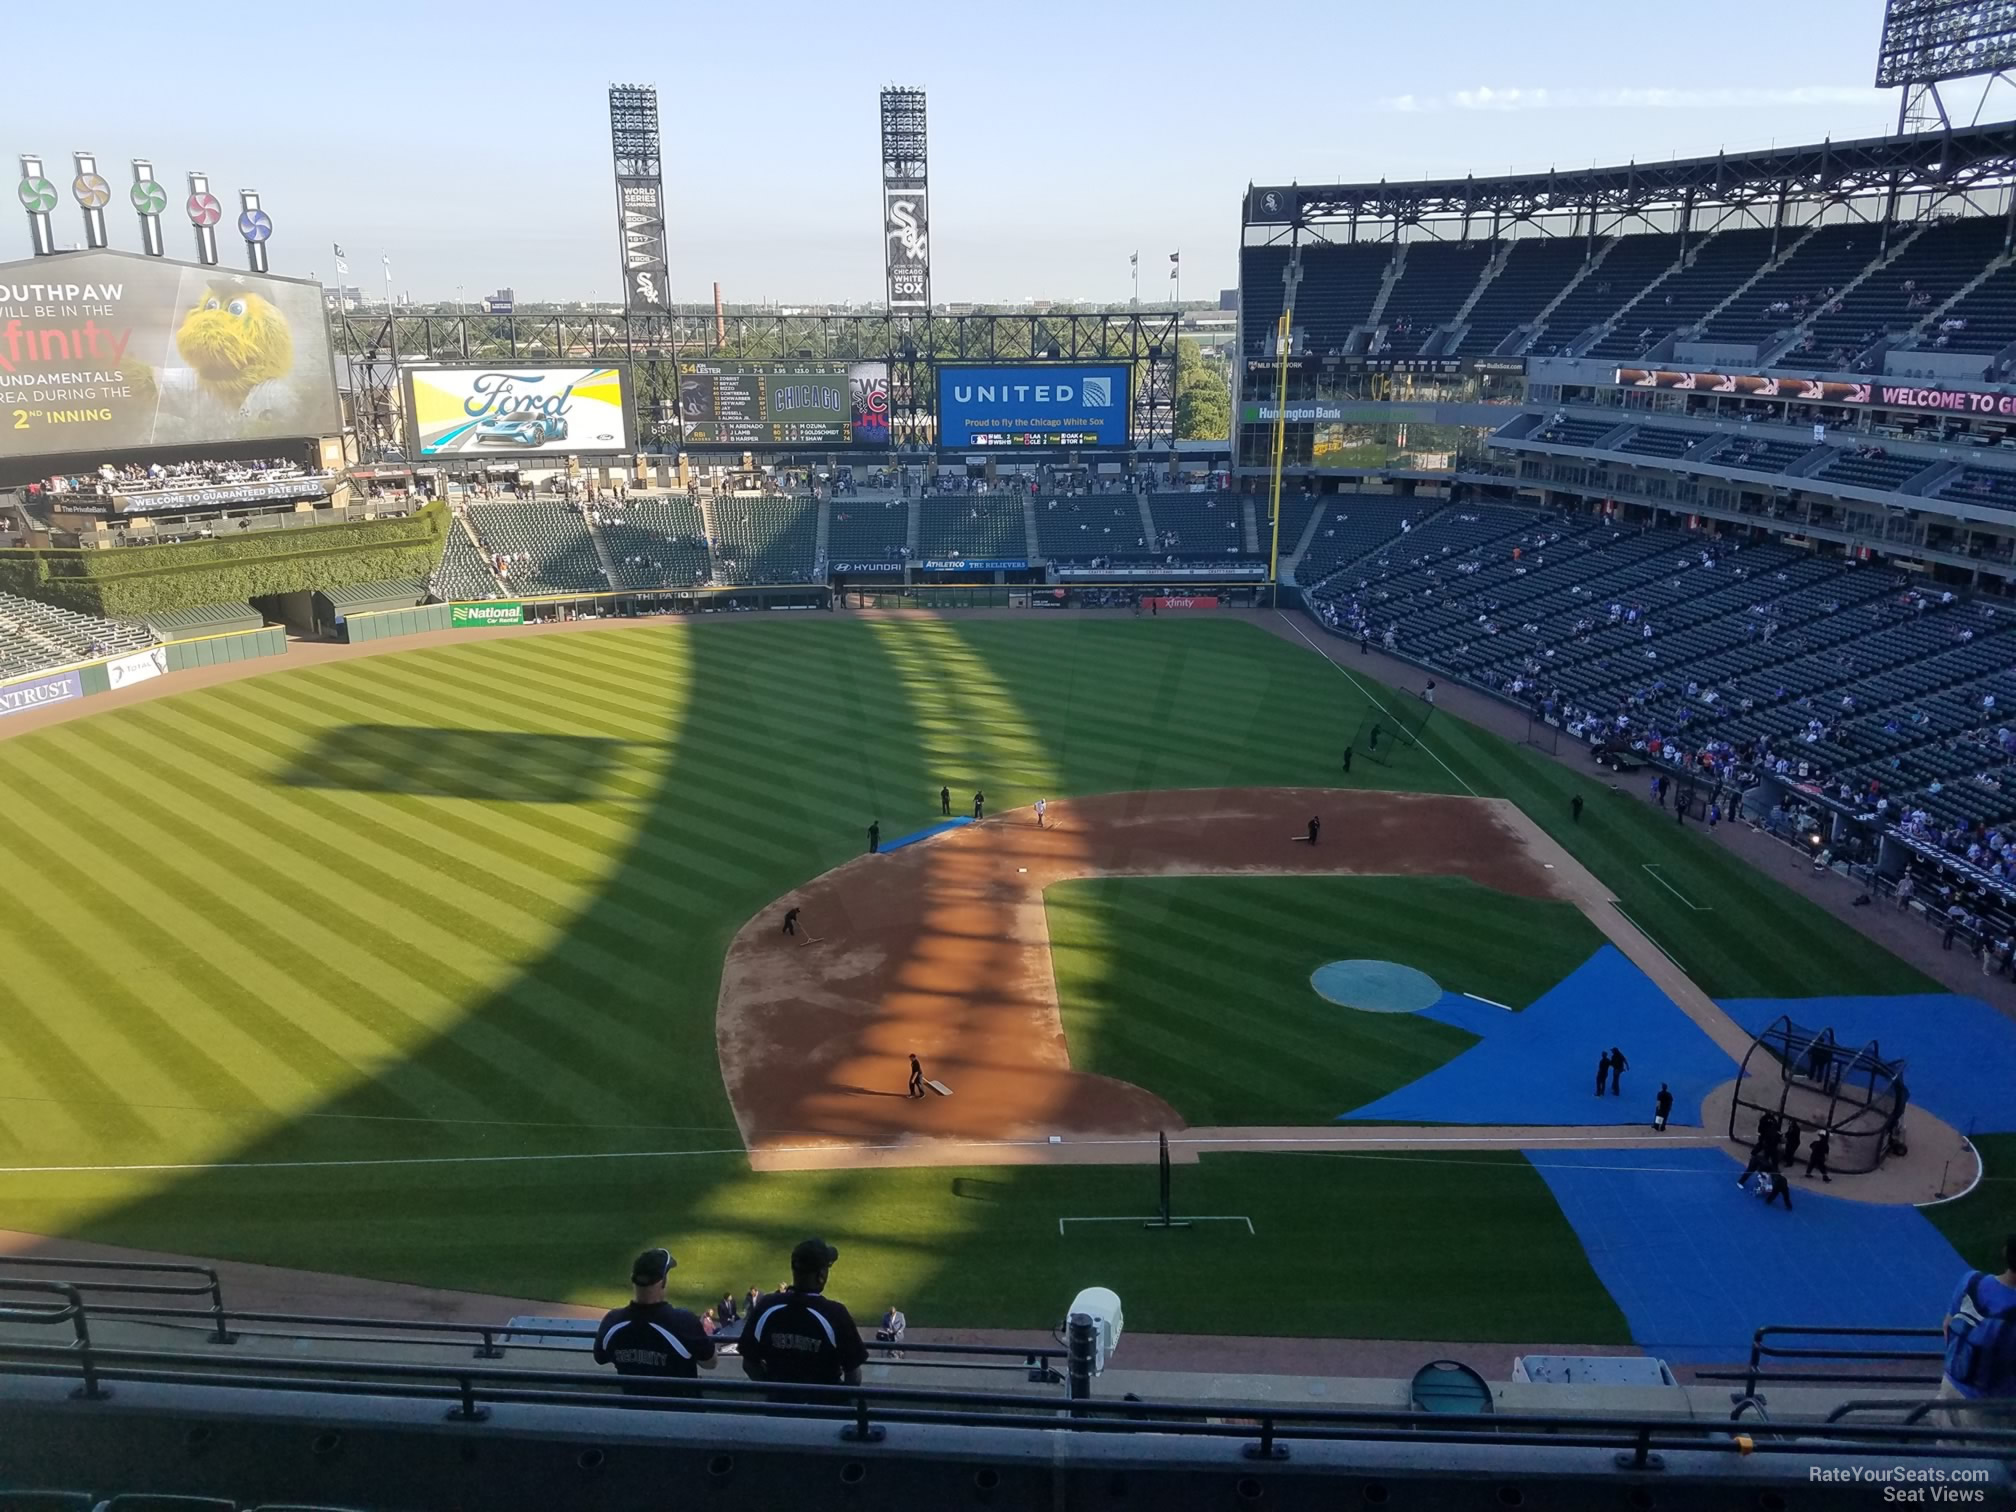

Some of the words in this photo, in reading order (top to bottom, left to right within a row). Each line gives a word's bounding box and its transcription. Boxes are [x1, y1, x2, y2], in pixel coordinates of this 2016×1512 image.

[894, 283, 924, 294] SOX
[34, 306, 56, 317] BE
[62, 306, 78, 316] IN
[82, 305, 114, 316] THE
[680, 364, 696, 374] 34
[34, 388, 96, 402] DURING
[101, 386, 132, 398] THE
[464, 373, 574, 417] Ford
[775, 384, 840, 412] CHICAGO
[954, 386, 1074, 402] UNITED
[1882, 388, 1966, 410] WELCOME
[1970, 394, 1994, 412] TO
[47, 408, 112, 424] INNING
[1316, 407, 1340, 418] Bank
[1002, 418, 1012, 428] fly
[1030, 418, 1061, 428] Chicago
[1063, 418, 1086, 426] White
[1089, 418, 1104, 426] Sox
[136, 496, 184, 506] WELCOME
[202, 488, 265, 501] GUARANTEED
[268, 487, 292, 496] RATE
[294, 484, 318, 492] FIELD
[1166, 598, 1194, 608] xfinity
